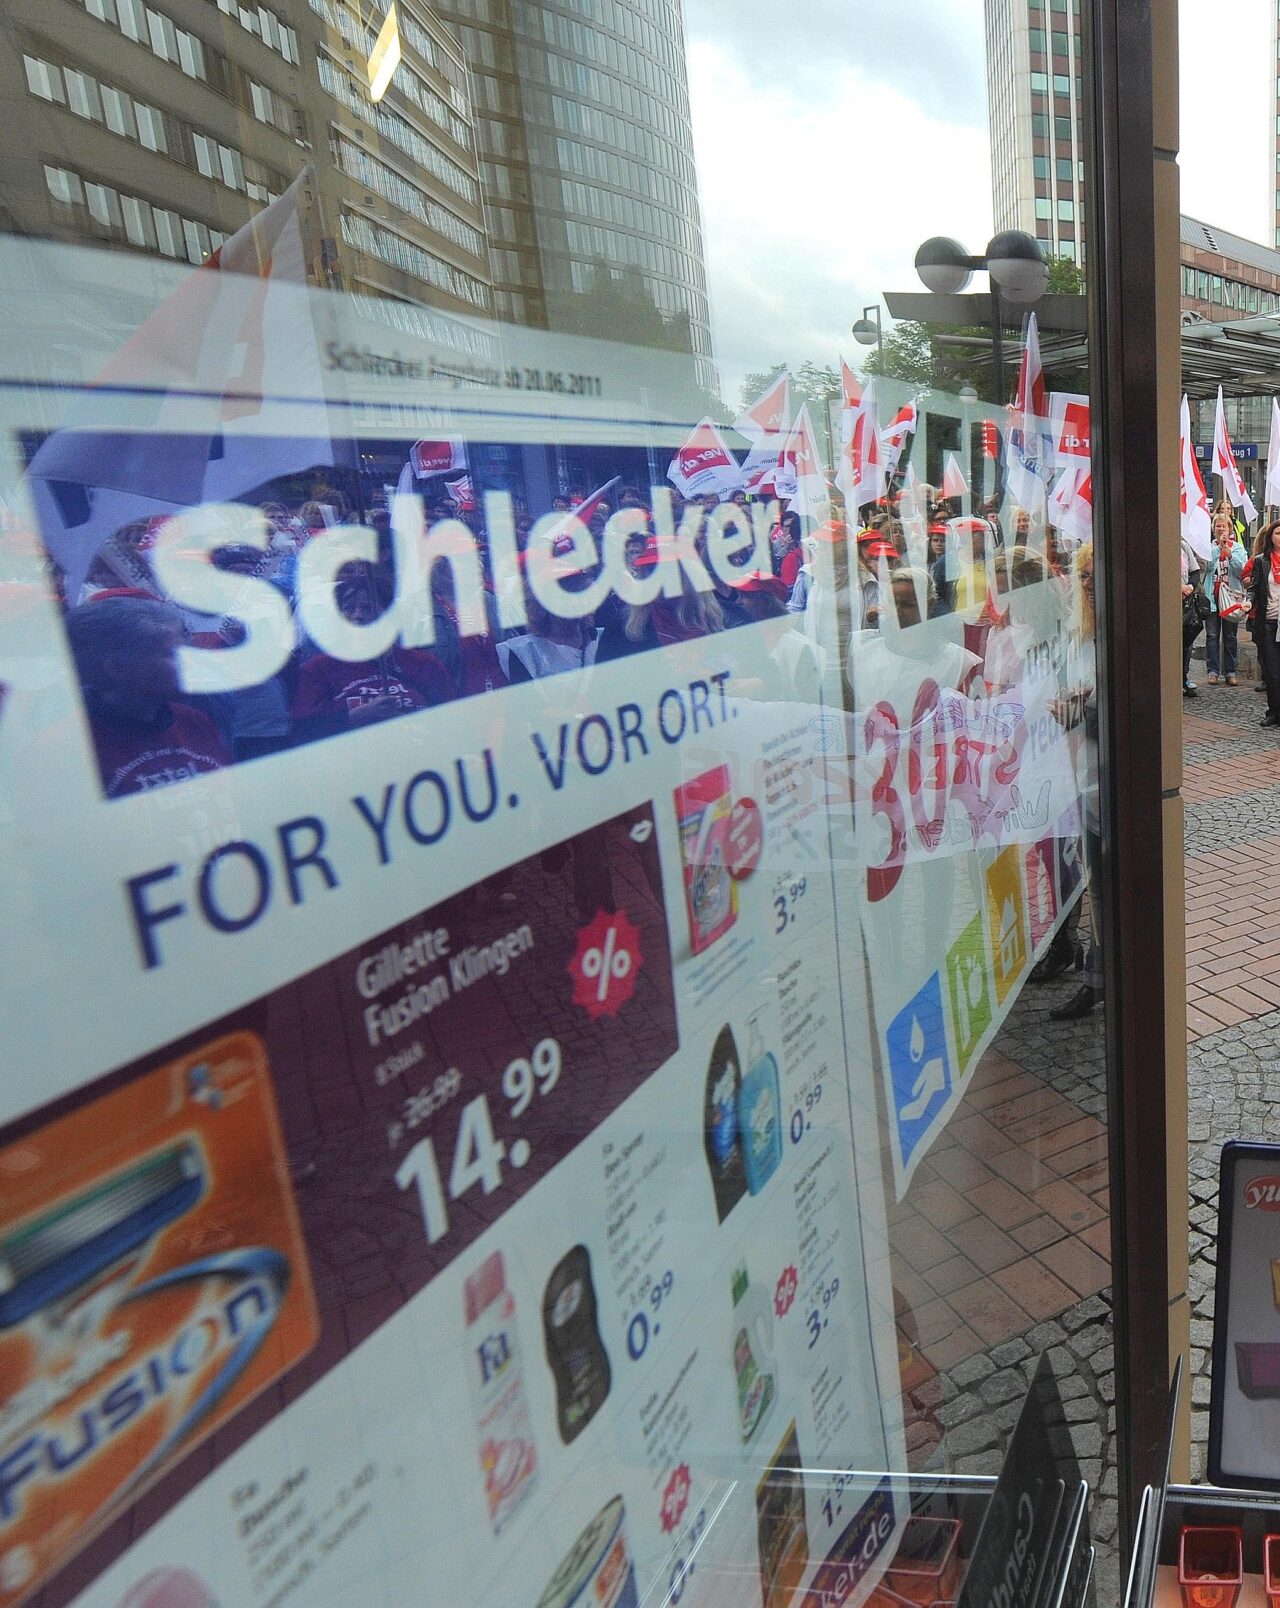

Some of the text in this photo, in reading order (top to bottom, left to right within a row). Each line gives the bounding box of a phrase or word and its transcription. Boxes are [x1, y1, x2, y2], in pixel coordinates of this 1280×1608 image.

[1246, 447, 1251, 456] 1
[152, 487, 777, 694] Schlecker
[124, 815, 341, 971] FOR
[353, 748, 520, 867] YOU.
[531, 704, 651, 791] VOR
[660, 670, 740, 746] ORT.
[356, 927, 450, 999] Gillette
[364, 924, 535, 1046] Fusion Klingen
[626, 1269, 674, 1362] 0.99
